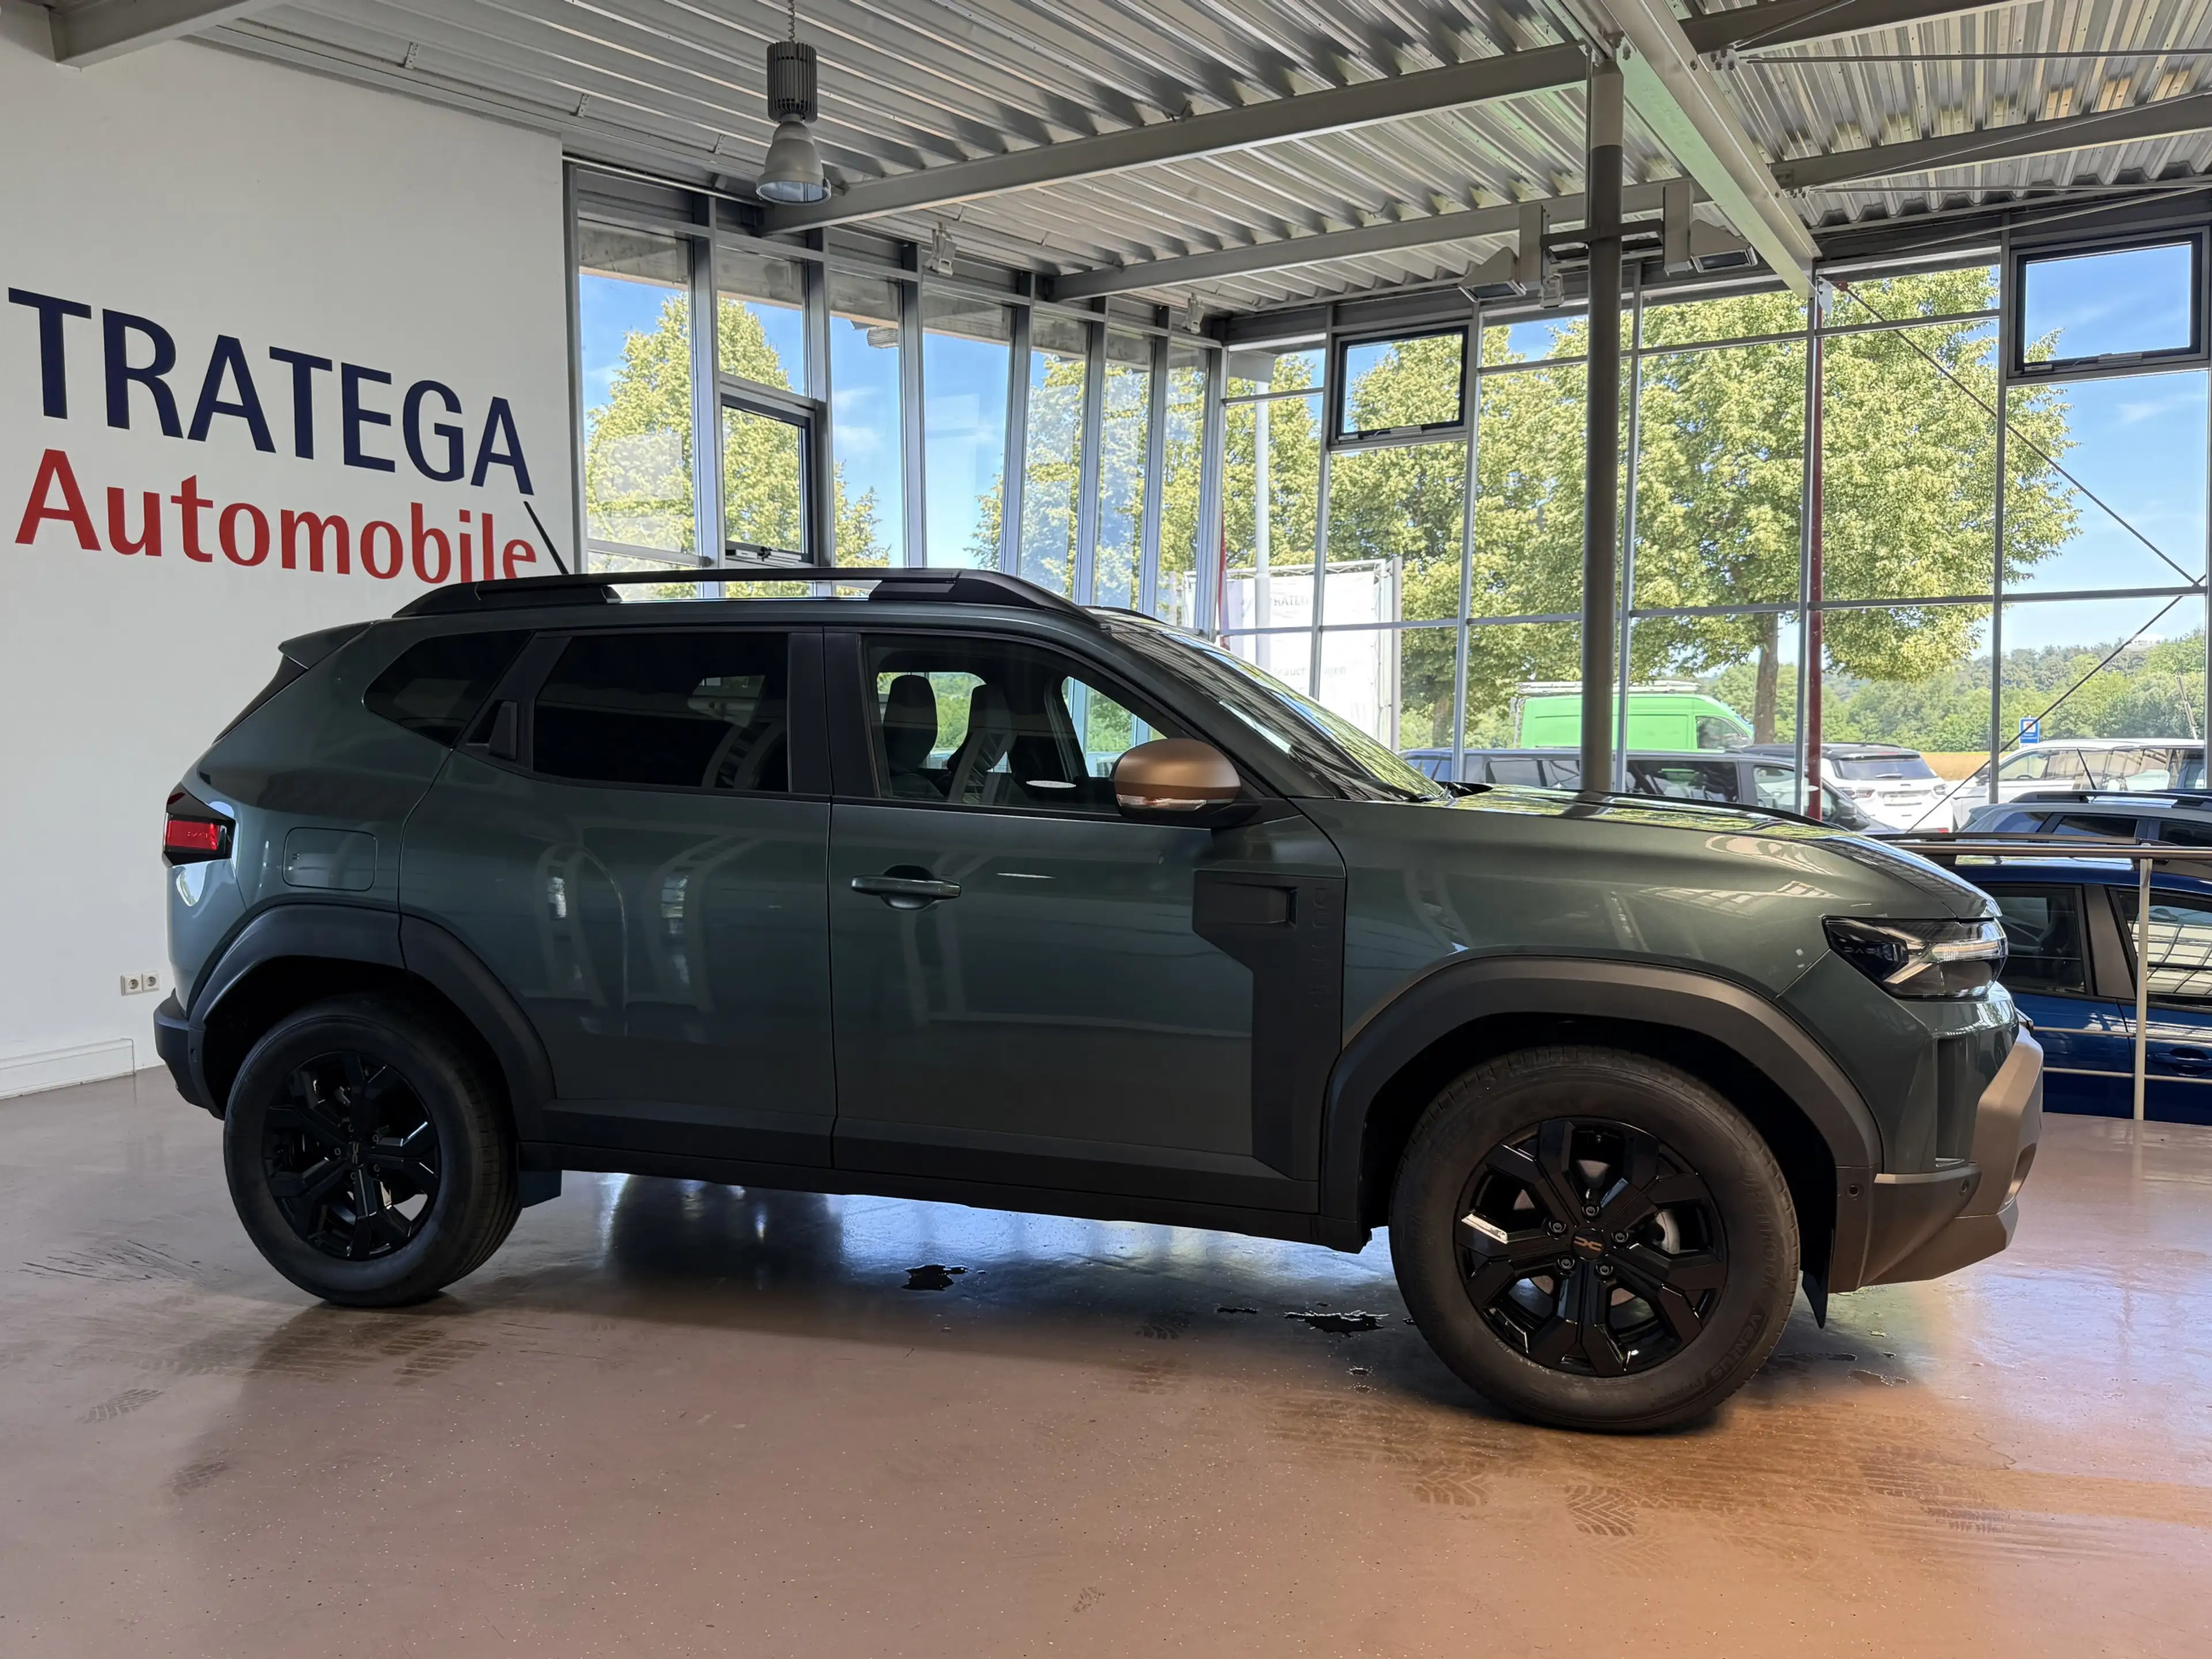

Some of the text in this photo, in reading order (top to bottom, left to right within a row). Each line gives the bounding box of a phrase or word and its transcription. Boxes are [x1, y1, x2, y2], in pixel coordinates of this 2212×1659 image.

[8, 287, 534, 495] TRATEGA
[16, 448, 536, 584] Automobile
[1269, 594, 1312, 607] RATEG
